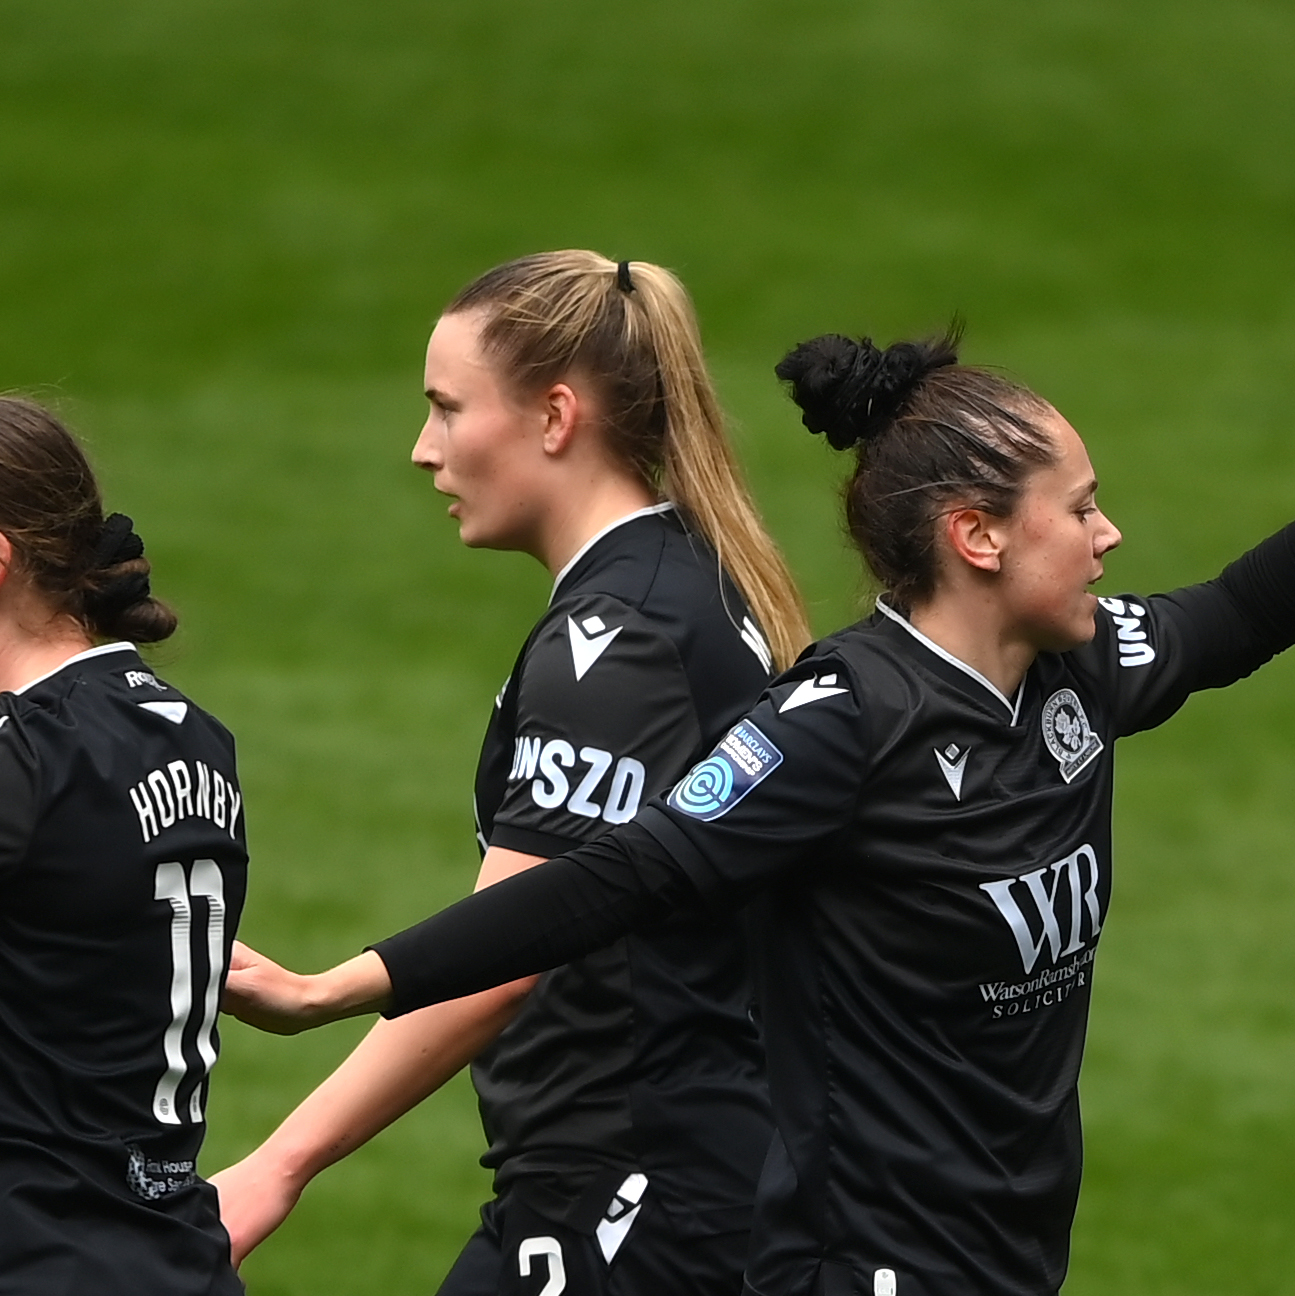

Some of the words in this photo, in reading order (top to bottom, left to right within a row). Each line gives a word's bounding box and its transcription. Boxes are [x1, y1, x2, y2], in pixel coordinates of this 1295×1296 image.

[738, 729, 772, 764] BARCLAYS
[129, 760, 241, 843] HORNBY
[979, 843, 1103, 975] WR
[153, 858, 226, 1125] 11
